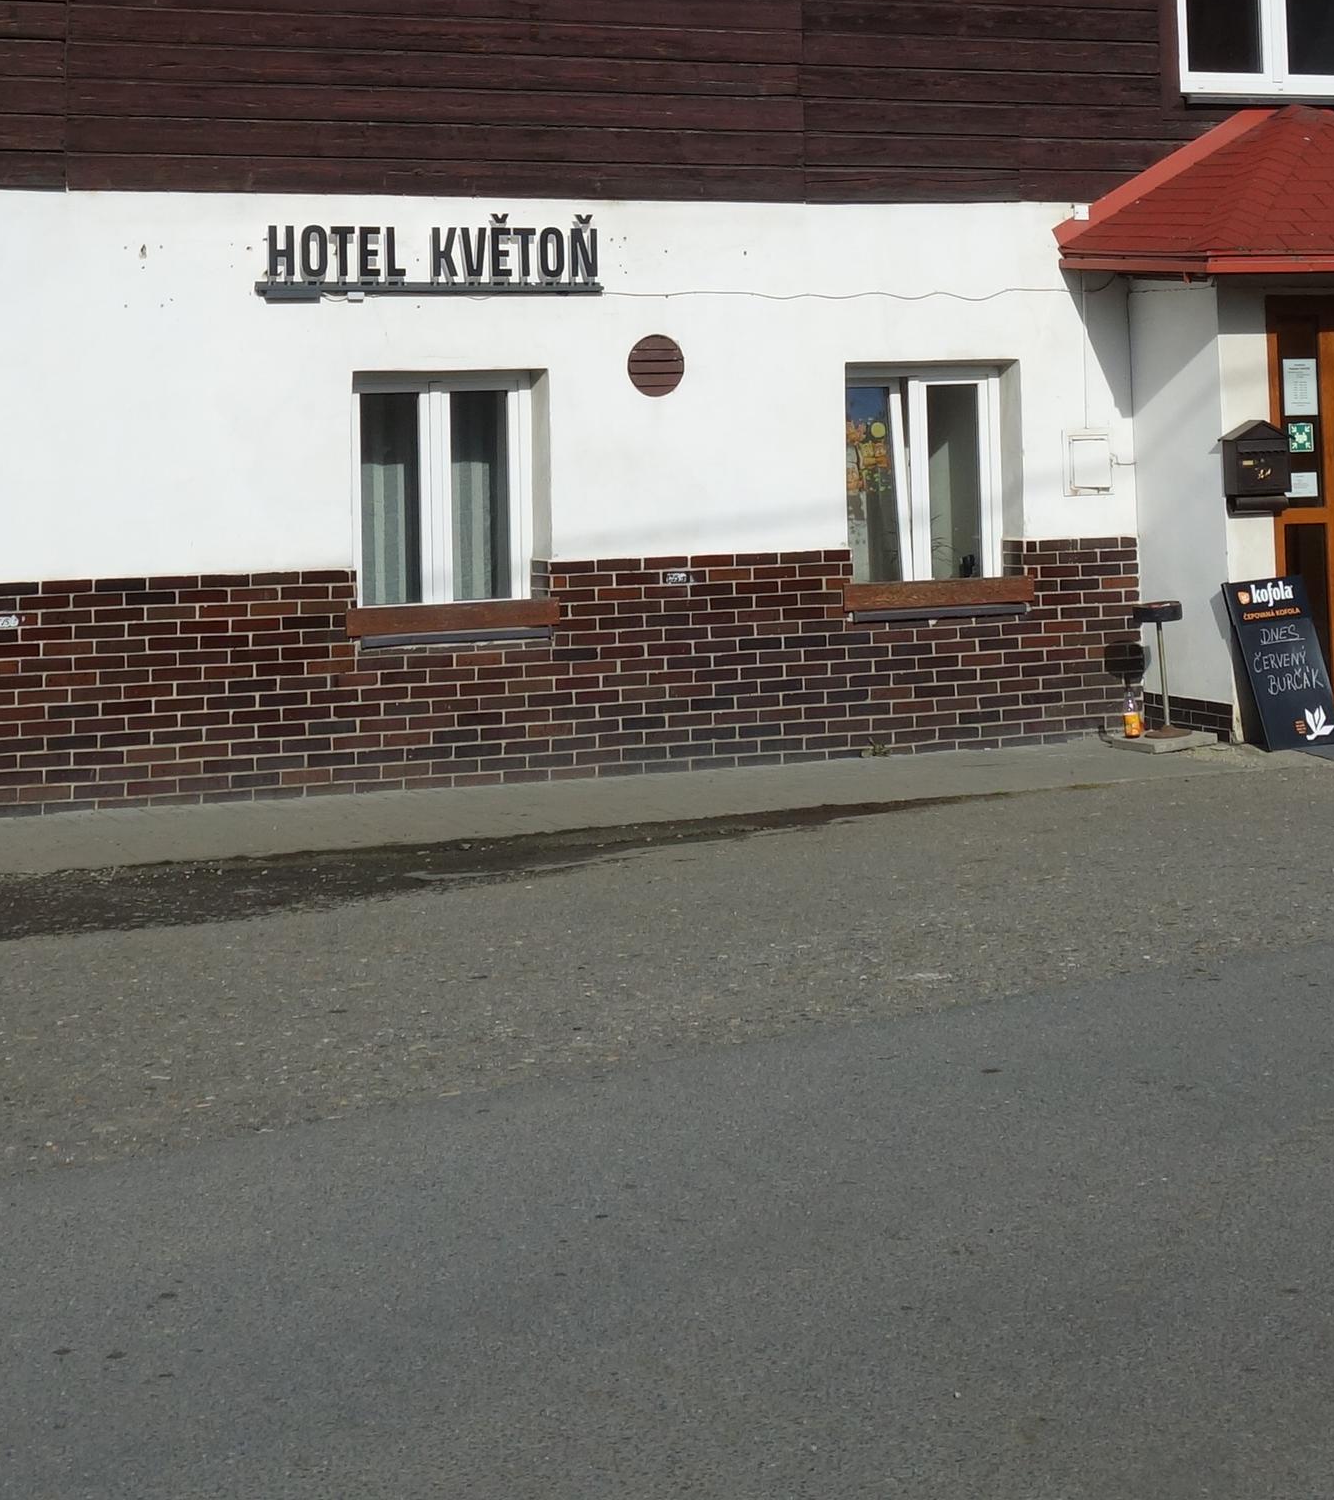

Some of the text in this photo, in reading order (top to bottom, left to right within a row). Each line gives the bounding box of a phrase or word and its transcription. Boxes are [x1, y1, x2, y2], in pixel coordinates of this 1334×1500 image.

[267, 213, 598, 278] HOTEL KVĚTOŇ
[1250, 580, 1294, 607] kofola
[1275, 607, 1301, 618] KOFOLA
[1260, 624, 1300, 644] DNES
[1253, 645, 1307, 673] ČERVENÝ
[1268, 665, 1324, 695] BURČÁK
